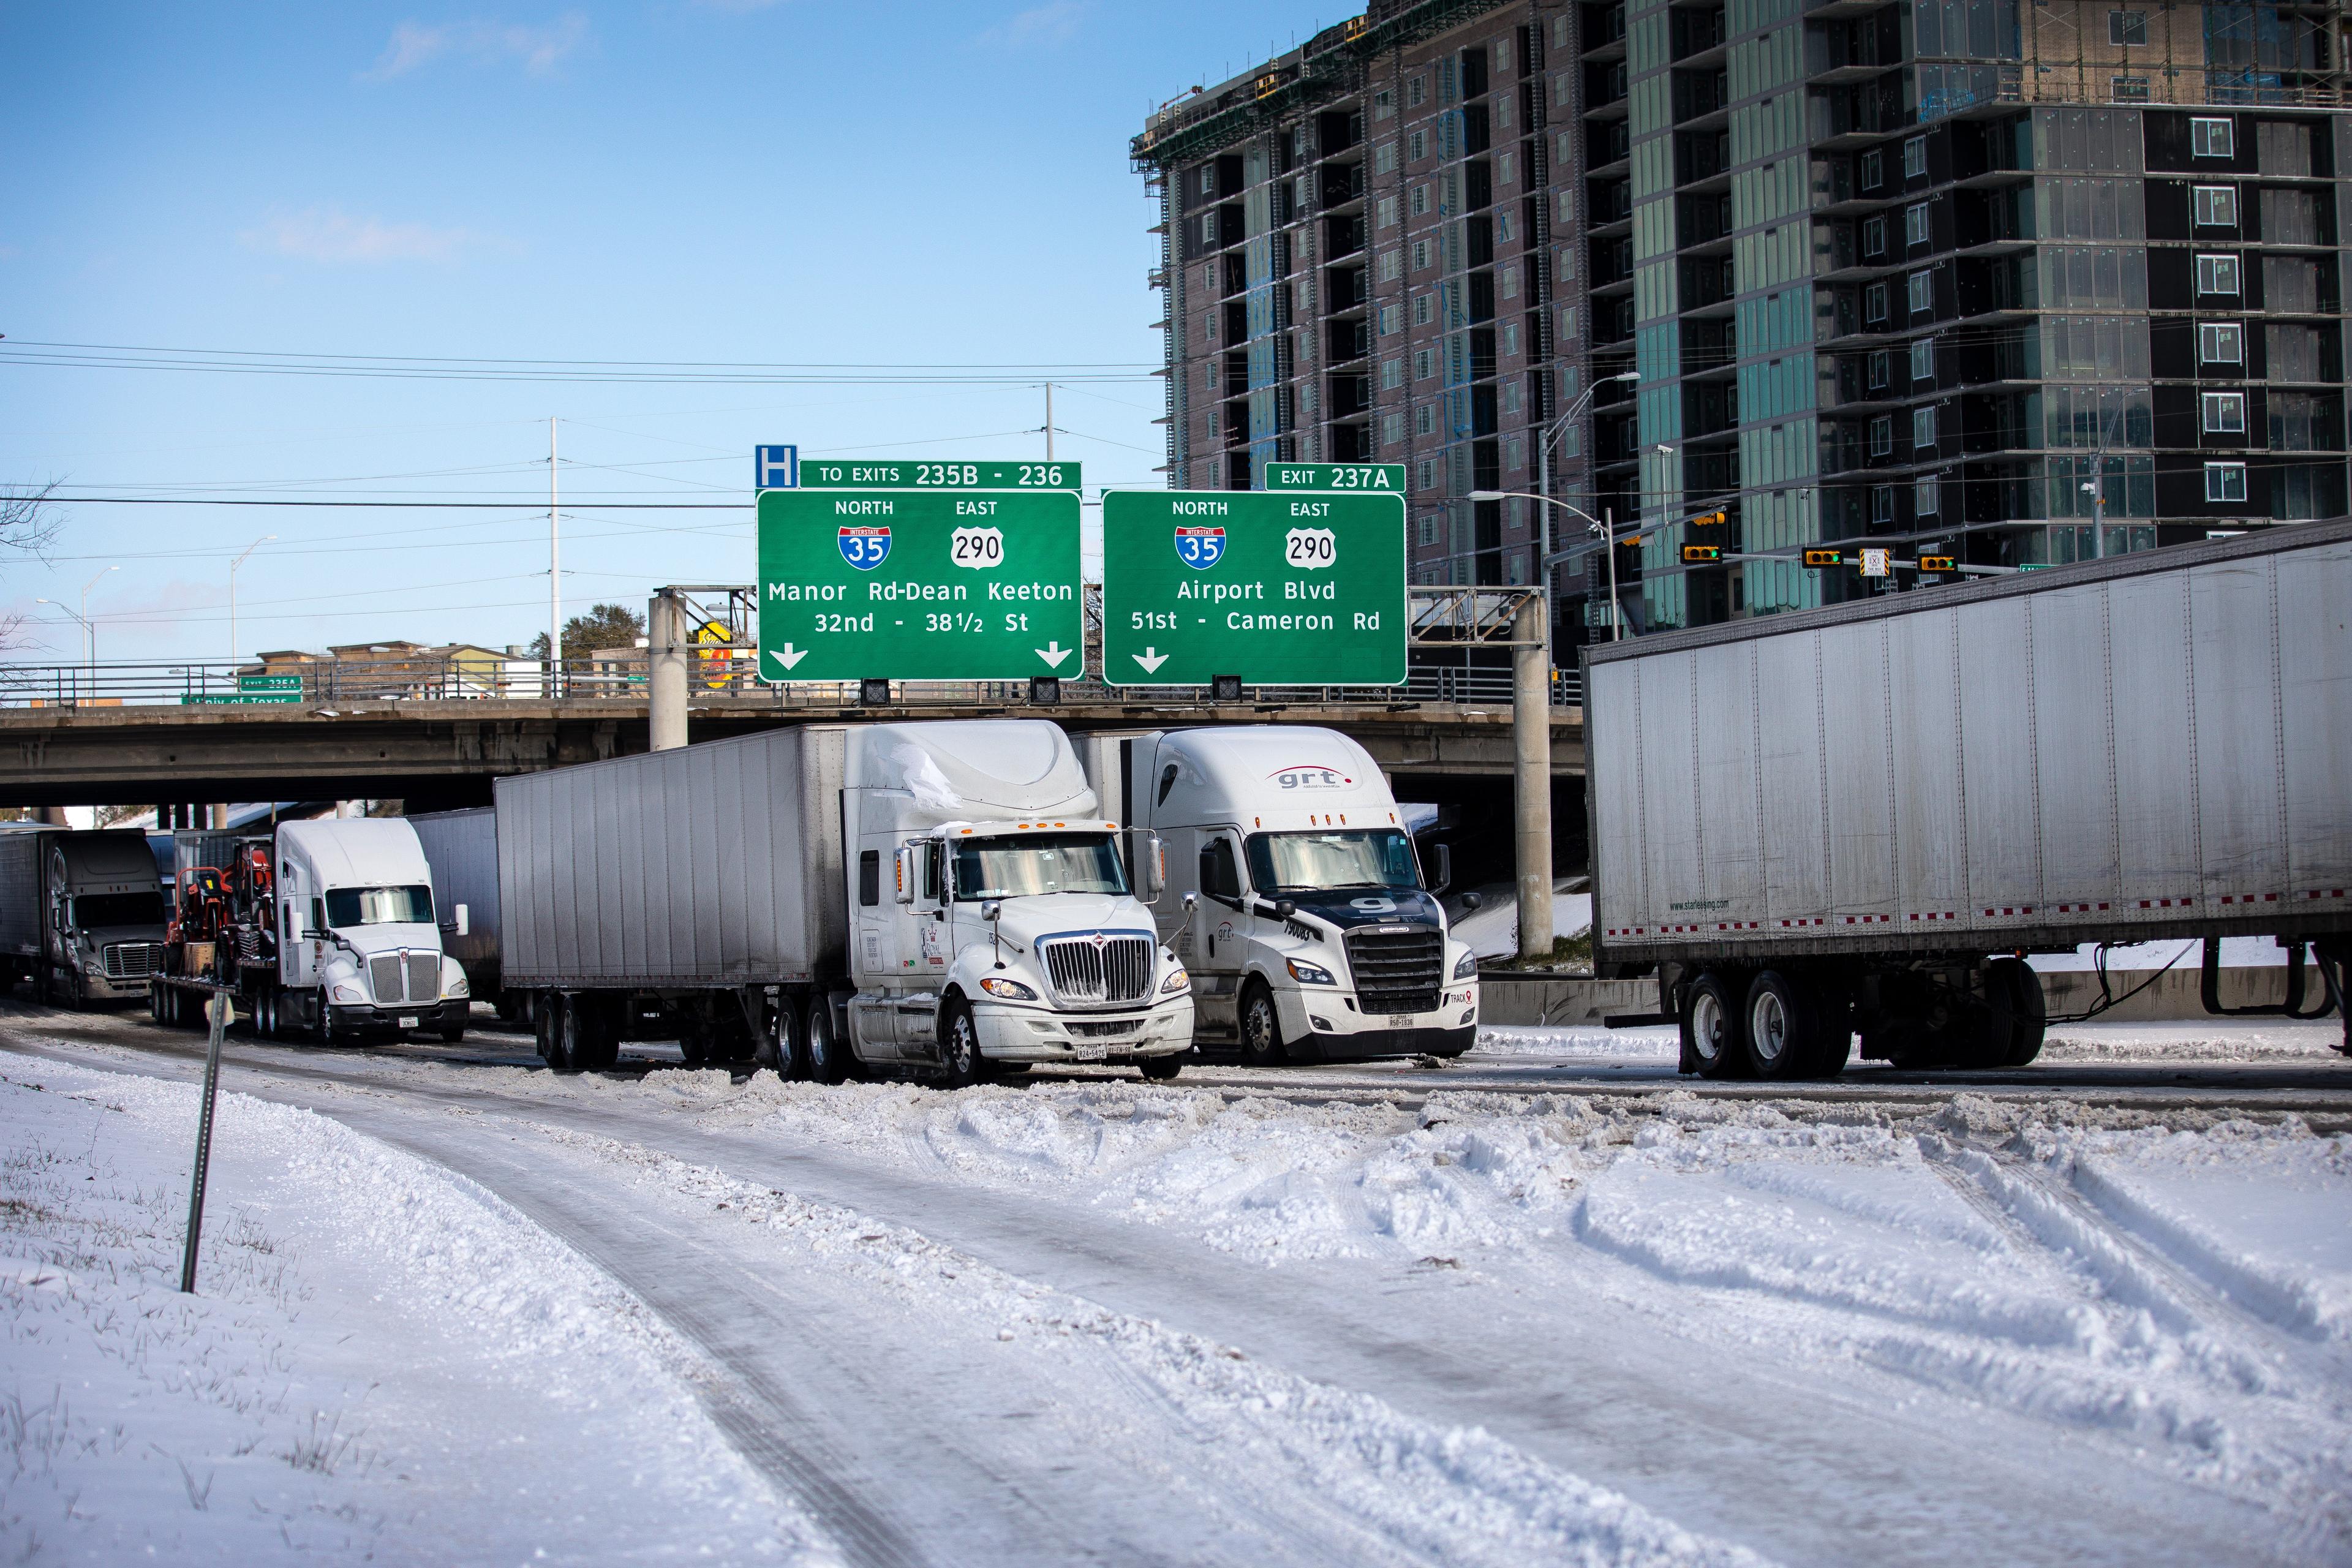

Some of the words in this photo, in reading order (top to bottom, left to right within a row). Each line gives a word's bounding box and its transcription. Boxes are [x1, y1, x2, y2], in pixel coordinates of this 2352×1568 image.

[761, 448, 791, 486] H
[820, 467, 842, 481] TO
[853, 467, 899, 481] EXITS
[916, 465, 978, 485] 235B
[1019, 466, 1062, 486] 236
[1281, 470, 1315, 484] EXIT
[1332, 467, 1390, 488] 237A
[835, 500, 893, 514] NORTH
[956, 501, 997, 515] EAST
[1172, 501, 1227, 515] NORTH
[1291, 503, 1330, 516] EAST
[848, 537, 883, 562] 35
[956, 535, 1000, 559] 290
[1184, 537, 1218, 561] 35
[1290, 537, 1332, 560] 290
[769, 582, 846, 601] Manor
[989, 582, 1072, 600] Keeton
[1177, 579, 1264, 604] Airport
[1285, 581, 1335, 600] Blvd
[815, 612, 873, 632] 32nd
[1005, 613, 1028, 631] St
[1132, 611, 1177, 630] 51st
[1227, 612, 1333, 630] Cameron
[1354, 611, 1379, 630] Rd
[1669, 899, 1729, 911] www.starleasing.com
[1450, 993, 1466, 1003] TRACK
